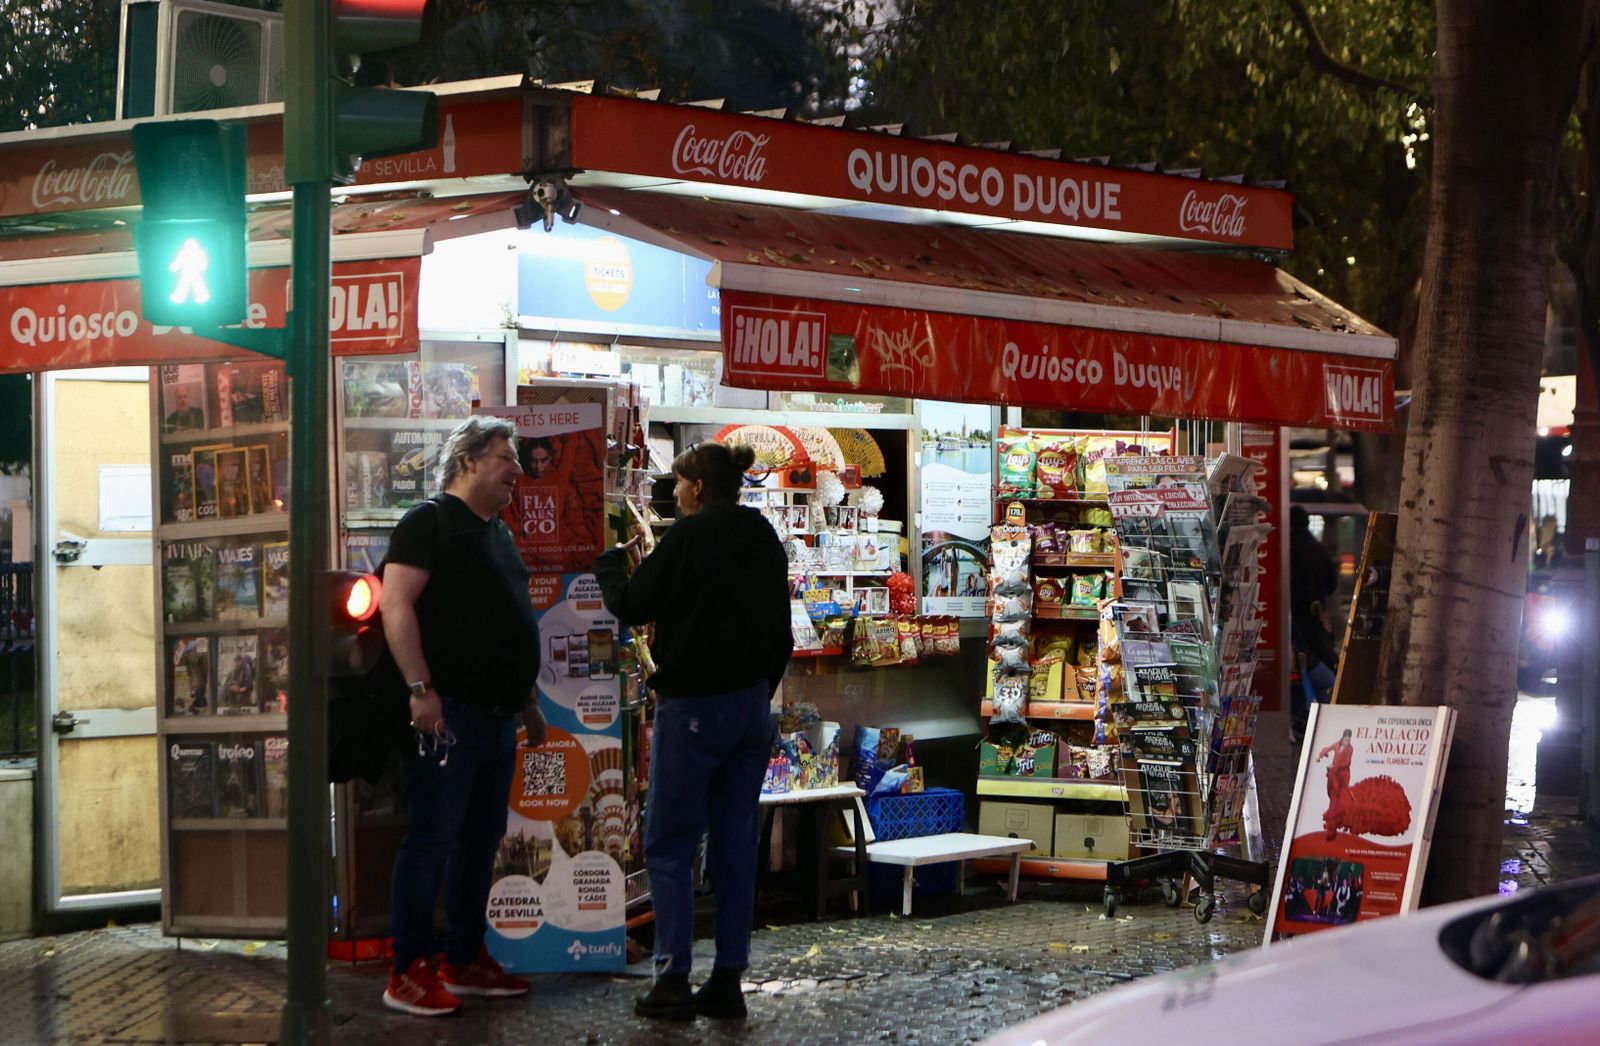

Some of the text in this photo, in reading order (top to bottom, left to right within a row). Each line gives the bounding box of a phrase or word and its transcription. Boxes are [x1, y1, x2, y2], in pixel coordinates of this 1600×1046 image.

[375, 157, 436, 176] SEVILLA
[847, 148, 1121, 223] QUIOSCO DUQUE
[594, 267, 625, 279] TICKETS
[10, 305, 138, 347] Quiosco
[734, 315, 820, 365] ¡HOLA!
[1001, 341, 1183, 391] Quiosco Duque
[550, 412, 580, 425] HERE
[1116, 457, 1195, 466] APRENDE LAS CLAVES
[1127, 465, 1148, 473] PARA
[523, 495, 556, 510] FLA
[523, 510, 555, 520] MEN
[1111, 505, 1161, 517] muy
[523, 519, 556, 534] CO
[564, 544, 577, 552] LOS
[218, 547, 253, 564] VIAJES
[534, 577, 557, 585] YOUR
[1029, 732, 1055, 746] Fritos
[1356, 726, 1430, 741] EL PALACIO
[546, 740, 577, 748] AHORA
[1366, 741, 1427, 756] ANDALUZ
[519, 798, 569, 808] BOOK NOW
[573, 868, 611, 876] CÓRDOBA
[491, 897, 541, 906] CATEDRAL
[489, 909, 544, 918] DE SEVILLA
